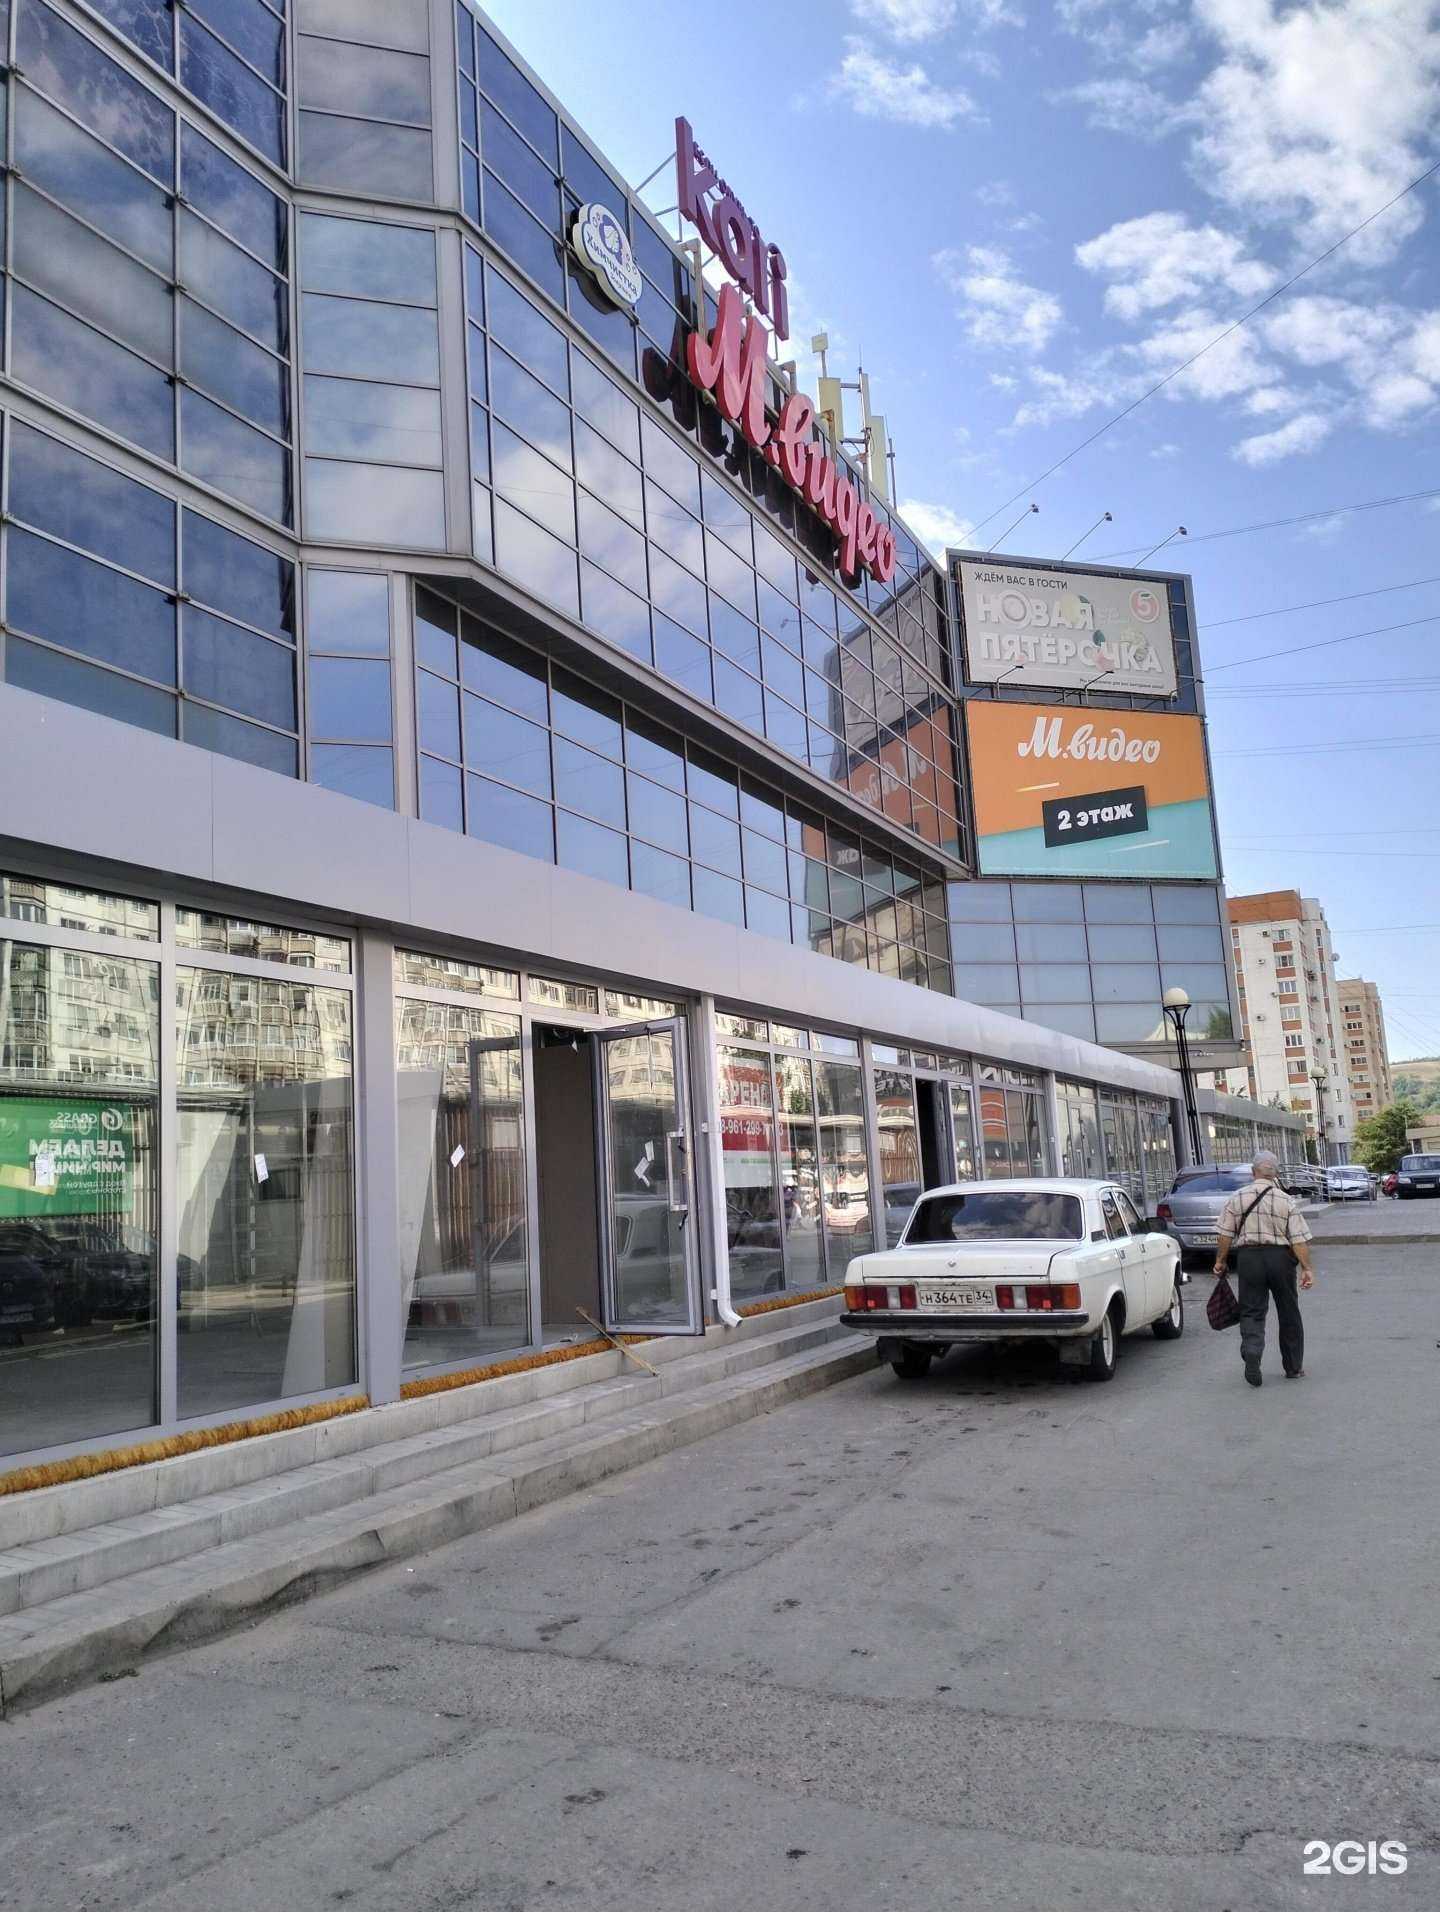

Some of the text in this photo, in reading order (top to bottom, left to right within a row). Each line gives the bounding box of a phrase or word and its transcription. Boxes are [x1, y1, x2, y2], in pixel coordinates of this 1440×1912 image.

[974, 571, 1068, 591] ЖДЁМ ВАС В ГОСТИ
[976, 589, 1095, 632] НОВАЯ
[1017, 716, 1161, 763] М.видео
[1057, 802, 1134, 830] 2 этаж
[925, 1291, 988, 1304] Н364ТЕ 34
